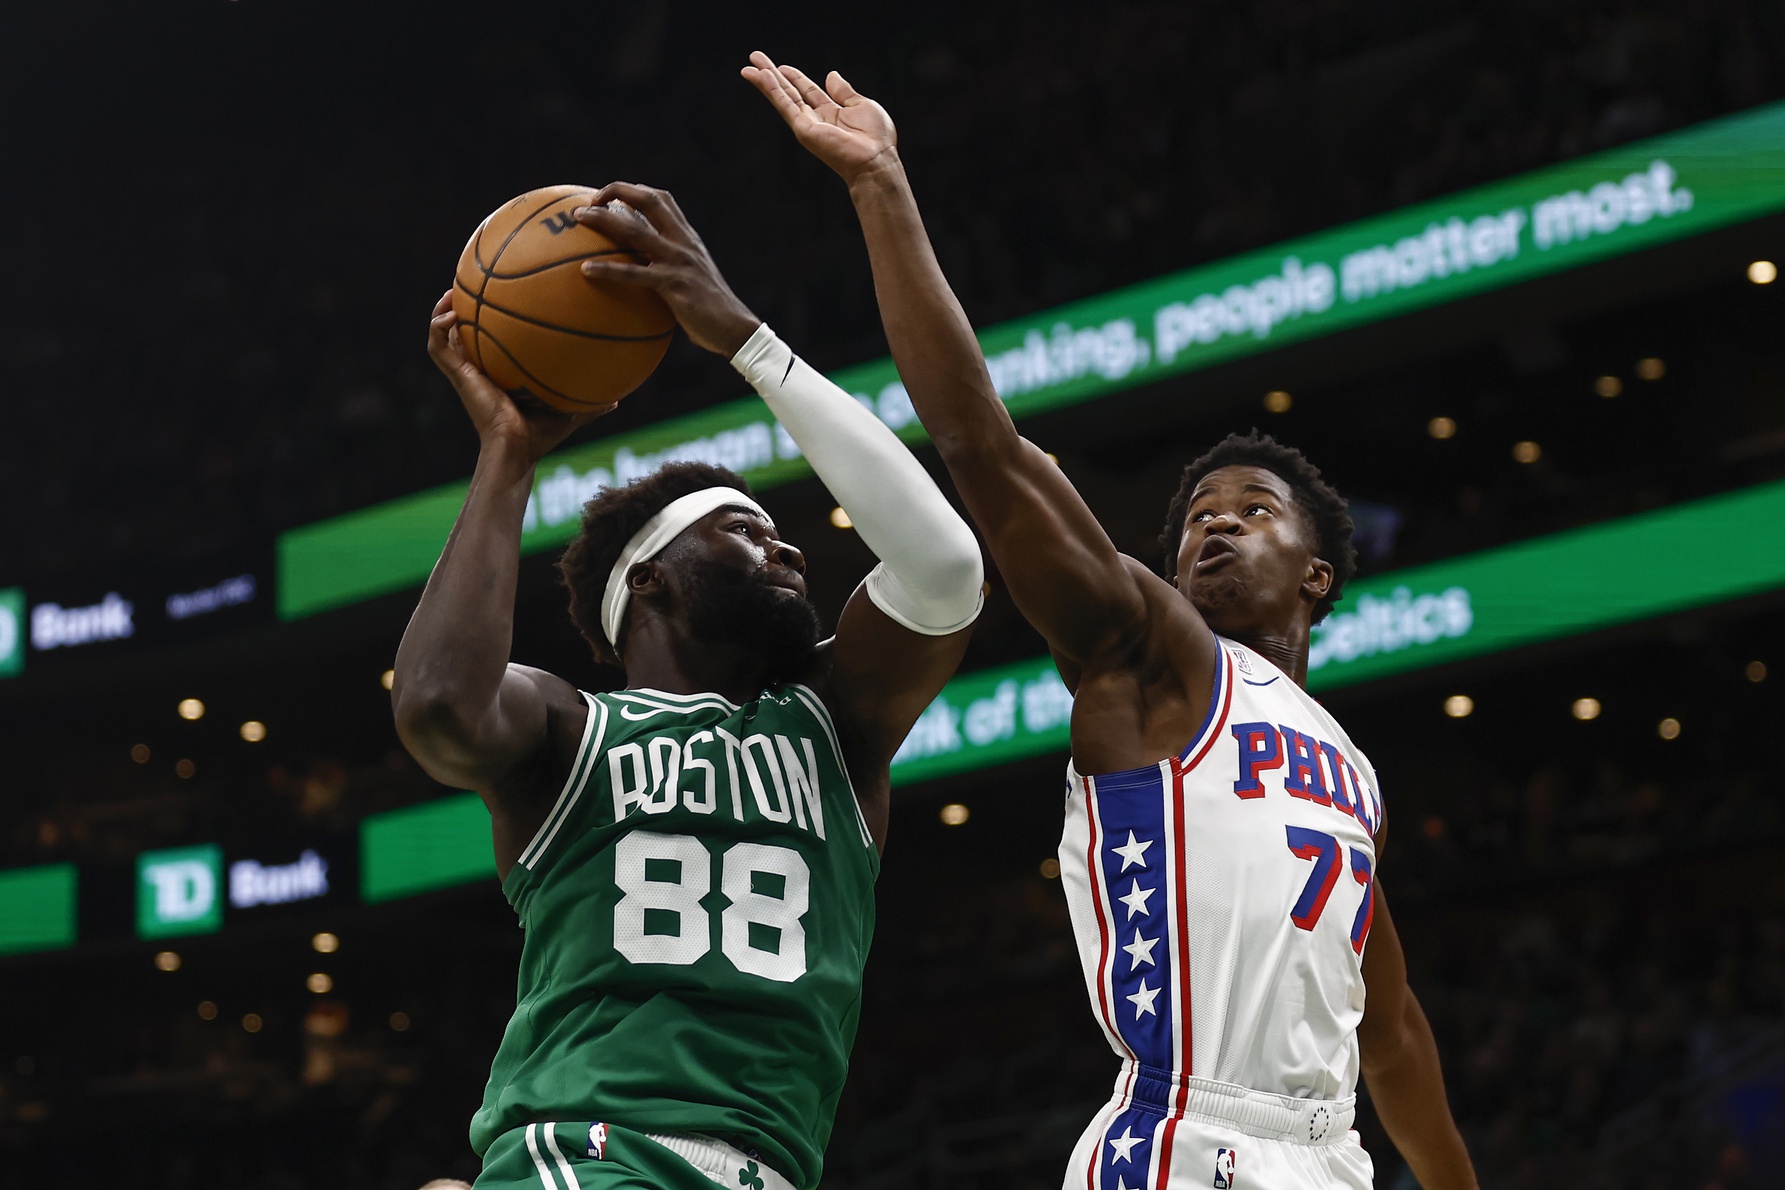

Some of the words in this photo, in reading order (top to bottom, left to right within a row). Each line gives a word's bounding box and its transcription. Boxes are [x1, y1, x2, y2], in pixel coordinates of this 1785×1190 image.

[985, 316, 1151, 399] nking,
[1154, 256, 1336, 366] people
[1339, 206, 1527, 304] matter
[1532, 158, 1694, 251] most.
[30, 591, 135, 651] Bank
[890, 696, 963, 766] nk
[963, 678, 1018, 746] of
[1021, 669, 1074, 733] th
[607, 726, 826, 841] BOSTON
[1231, 721, 1381, 839] PHIL
[142, 860, 216, 924] TD
[229, 848, 329, 909] Bank
[613, 829, 811, 983] 88
[1285, 824, 1374, 956] 77
